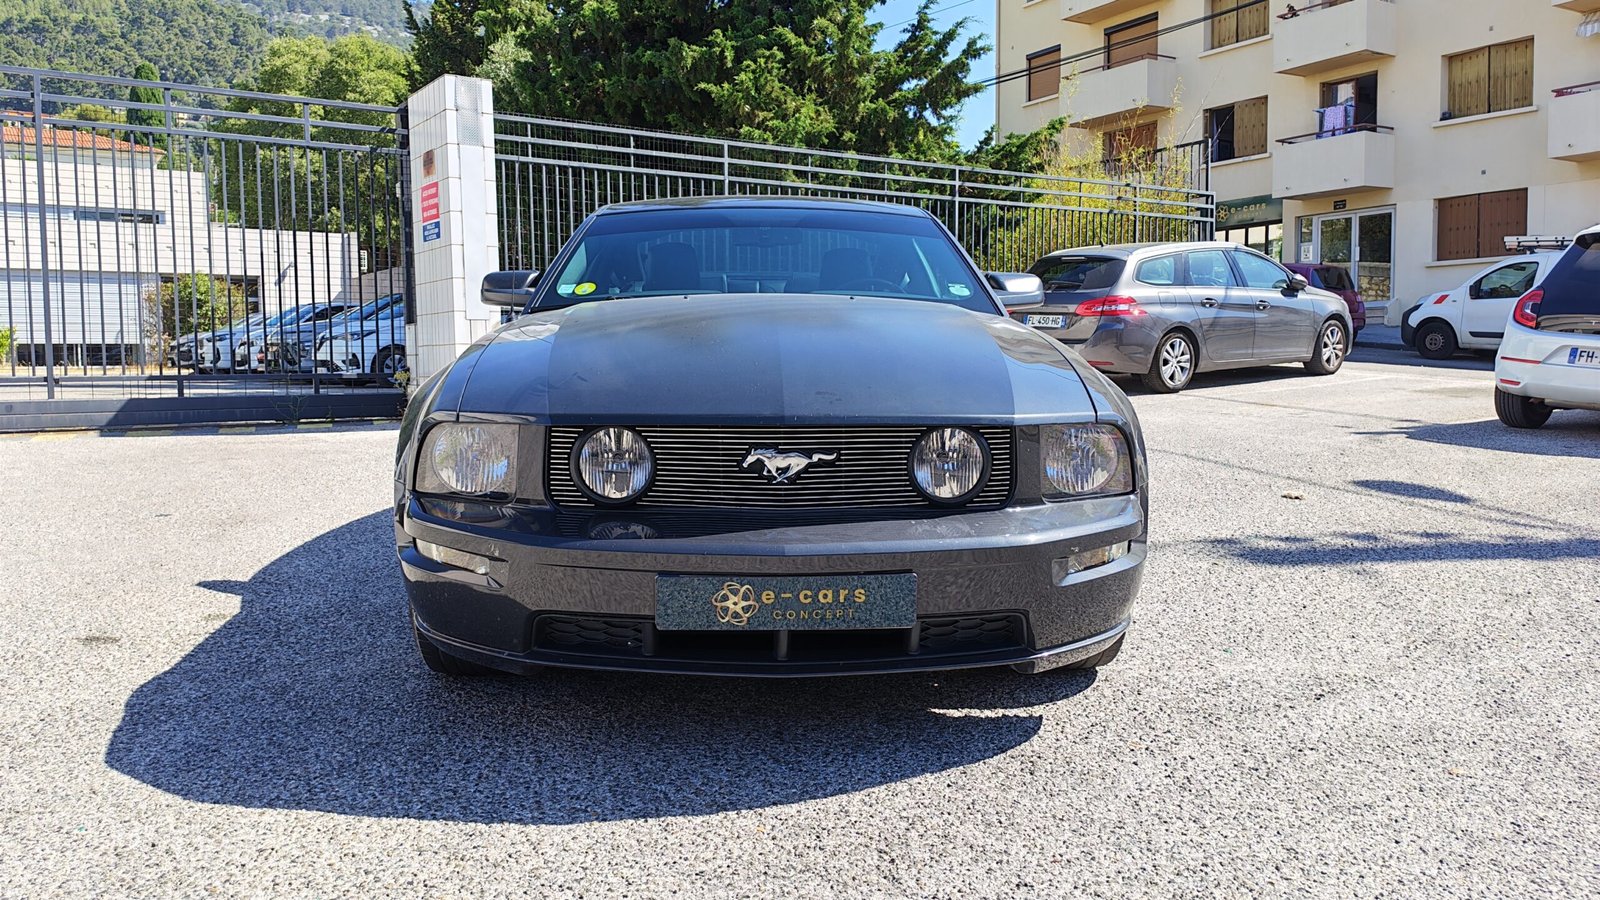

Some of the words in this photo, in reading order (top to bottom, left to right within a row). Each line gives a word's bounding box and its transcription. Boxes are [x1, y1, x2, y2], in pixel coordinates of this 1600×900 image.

[1577, 350, 1600, 364] FH-
[761, 588, 866, 604] e-cars
[773, 609, 855, 619] CONCEPT
